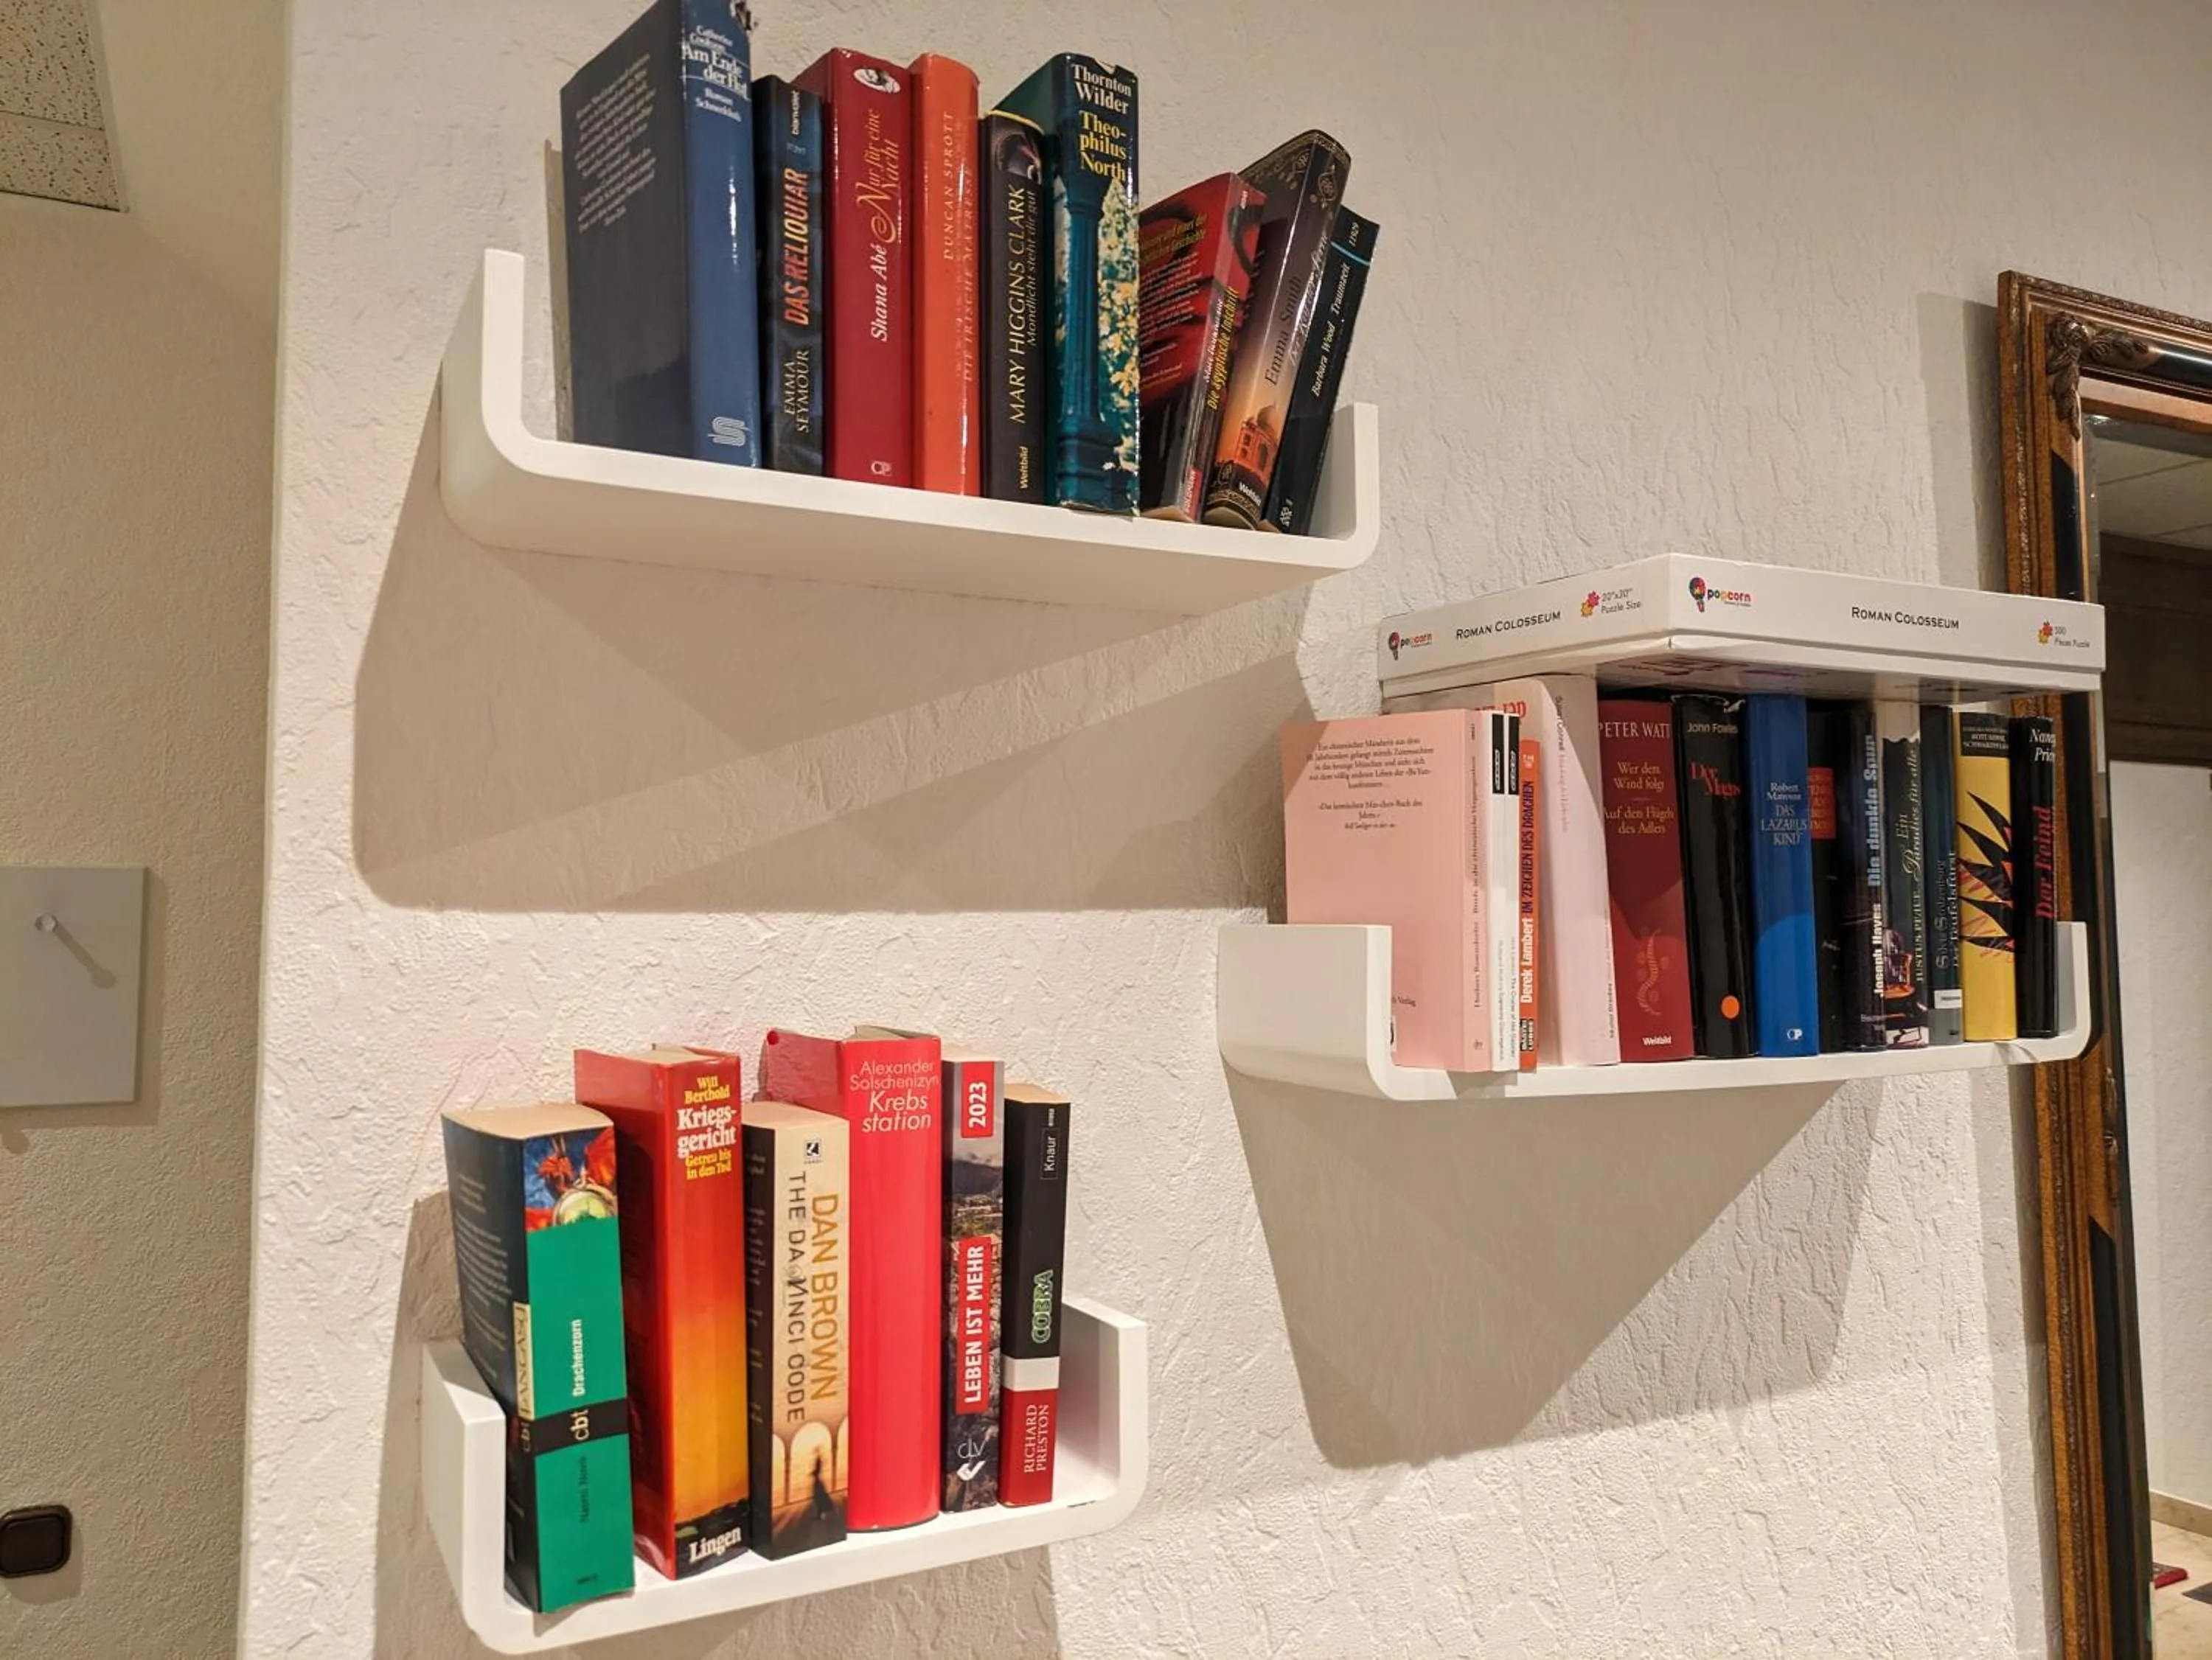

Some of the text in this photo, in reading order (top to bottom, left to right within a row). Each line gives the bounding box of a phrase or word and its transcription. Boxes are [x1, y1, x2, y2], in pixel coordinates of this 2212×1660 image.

[681, 41, 742, 77] Am Ende
[703, 64, 726, 85] der
[1071, 63, 1132, 98] Thornton
[1074, 82, 1129, 114] Wilder
[1079, 110, 1127, 139] Theo-
[1079, 133, 1127, 161] philus
[857, 108, 901, 244] Nur für eine
[883, 139, 900, 193] Nacht
[1080, 151, 1126, 183] North
[942, 111, 955, 261] DUNCAN SPROTT
[1026, 190, 1037, 215] gut
[785, 167, 810, 270] RELIQUIAR
[1026, 240, 1036, 272] steht
[784, 273, 810, 325] DAS
[869, 243, 888, 343] Shana Abé
[961, 269, 973, 341] IRISCHE
[1007, 184, 1026, 424] MARY HIGGINS CLARK
[1025, 276, 1036, 346] Mondlicht
[1263, 274, 1302, 388] Emma Smith
[1311, 263, 1352, 400] Barbara Wood Traumzeit
[1207, 387, 1220, 412] Die
[1222, 285, 1239, 331] Inschrift
[961, 351, 973, 382] DIE
[785, 360, 796, 416] EMMA
[797, 349, 810, 433] SEYMOUR
[1017, 446, 1029, 489] Weltbild
[1600, 601, 1642, 614] Puzzle Size
[1707, 589, 1752, 603] popcorn
[1455, 611, 1561, 640] ROMAN COLOSSEUM
[1851, 607, 1960, 630] ROMAN COLOSSEUM
[1400, 633, 1433, 649] popcorn
[1686, 722, 1739, 734] John Fowles
[1613, 777, 1643, 790] Wind
[1617, 761, 1638, 774] Wer
[1770, 781, 1798, 792] Robert
[1908, 779, 1921, 803] für
[1521, 780, 1534, 829] DRACHEN
[1624, 806, 1644, 819] den
[1775, 804, 1795, 817] DAS
[1863, 735, 1882, 887] Die dunkle Spur
[1521, 830, 1534, 851] DES
[1618, 821, 1635, 834] des
[1773, 832, 1801, 846] KIND
[1895, 812, 1909, 839] Ein
[1902, 808, 1922, 883] Paradies
[2032, 804, 2057, 920] Der Feind
[1521, 853, 1534, 899] ZEICHEN
[1521, 900, 1534, 913] IM
[1521, 918, 1534, 966] Lambert
[1872, 903, 1886, 997] Joseph Hayes
[1520, 969, 1533, 1003] Derek
[1641, 1035, 1672, 1046] Weltbild
[849, 1073, 939, 1092] Solschenizyn
[859, 1060, 934, 1076] Alexander
[684, 1084, 731, 1105] Berthold
[869, 1089, 928, 1113] Krebs
[968, 1081, 988, 1129] 2023
[676, 1105, 737, 1131] Kriegs-
[861, 1112, 932, 1134] station
[676, 1123, 737, 1159] gericht
[685, 1148, 731, 1168] Getreu bis
[1043, 1135, 1057, 1172] Knaur
[686, 1168, 698, 1180] in
[698, 1164, 716, 1178] den
[716, 1159, 732, 1173] Tod
[811, 1193, 839, 1265] DAN
[786, 1170, 809, 1424] THE DA VINCI CODE
[1031, 1268, 1054, 1345] COBRA
[810, 1272, 839, 1401] BROWN
[964, 1244, 984, 1403] LEBEN IST MEHR
[520, 1421, 531, 1452] cbt
[570, 1408, 590, 1442] cbt
[1023, 1403, 1038, 1474] RICHARD
[1036, 1403, 1050, 1472] PRESTON
[688, 1526, 742, 1564] Lingen
